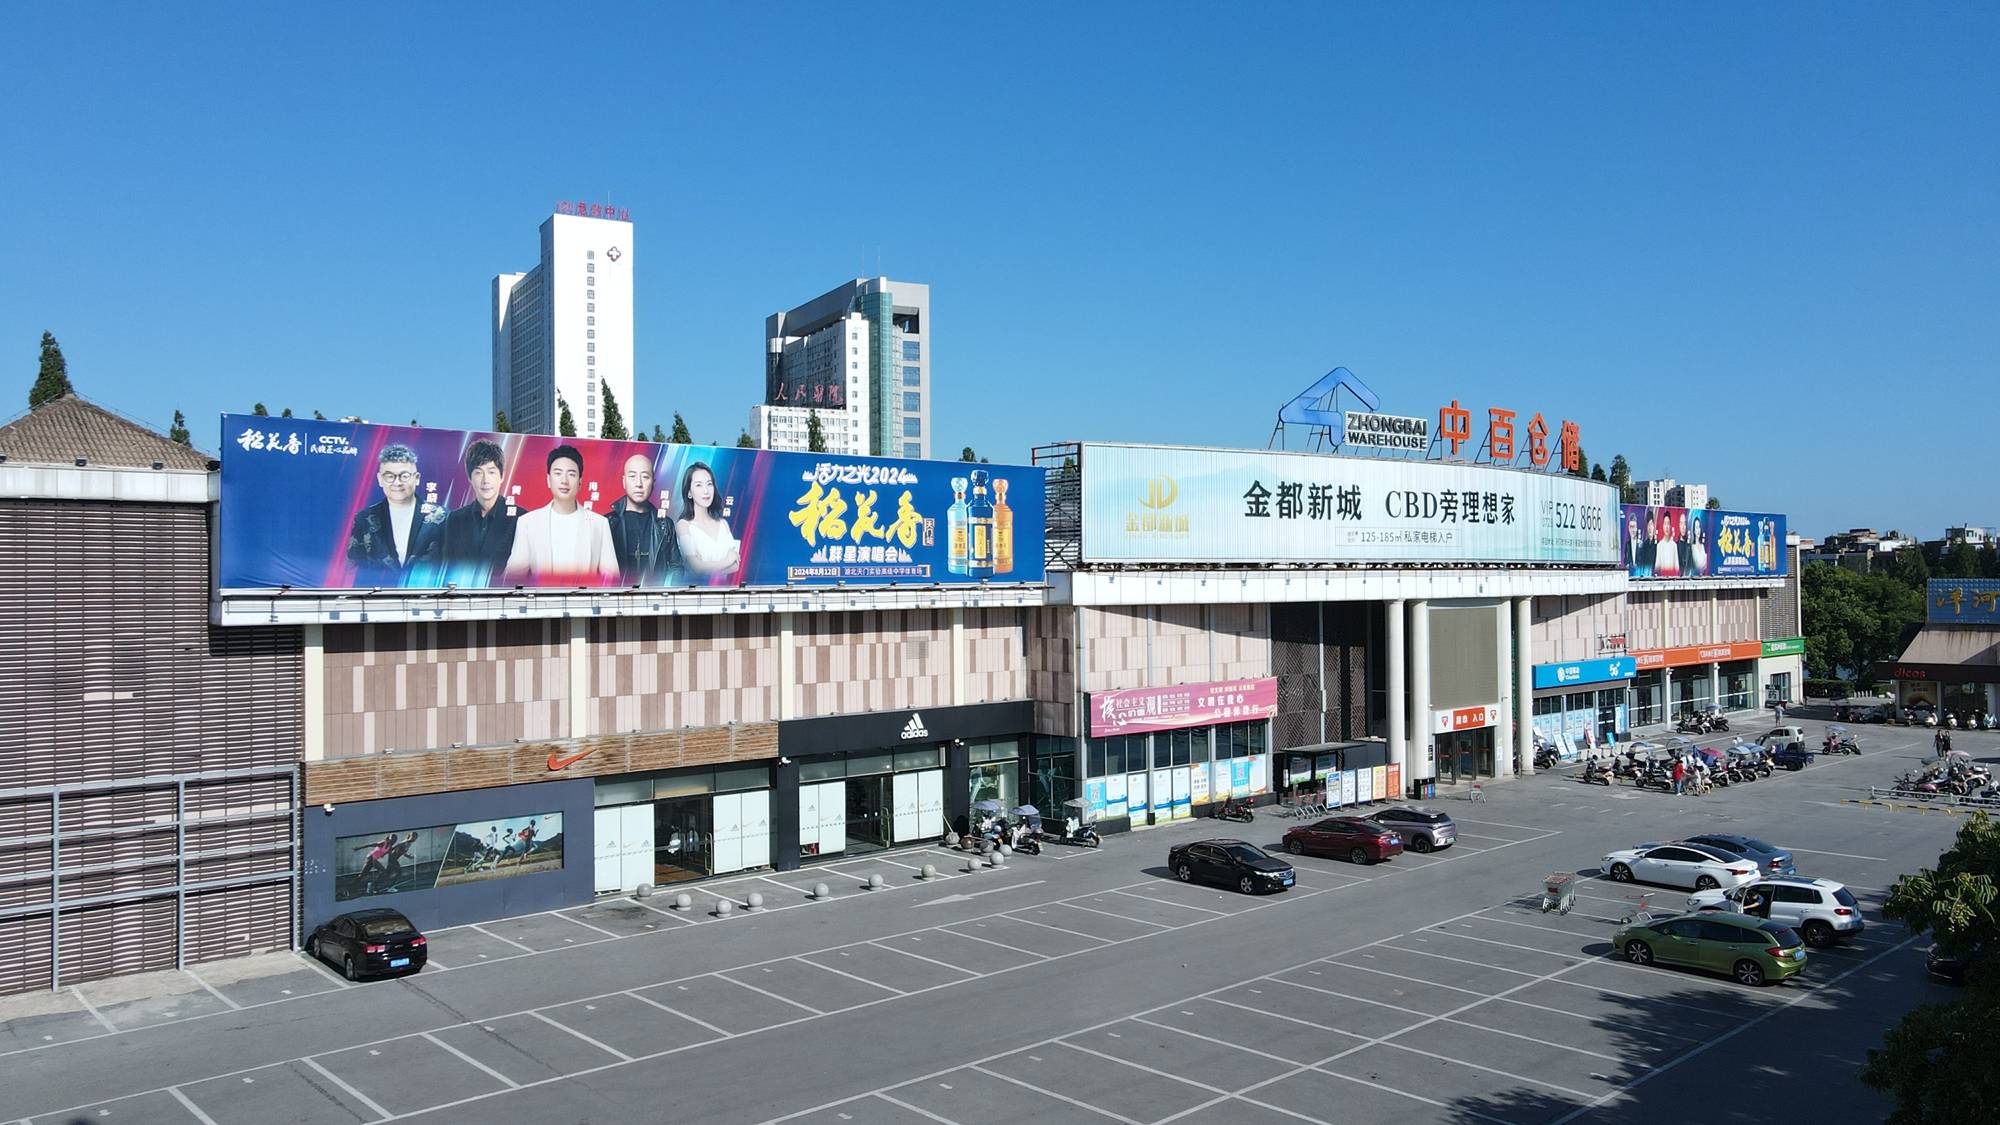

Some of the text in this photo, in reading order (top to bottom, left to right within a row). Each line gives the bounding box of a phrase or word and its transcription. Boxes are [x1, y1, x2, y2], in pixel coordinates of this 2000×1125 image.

[1347, 413, 1427, 436] ZHONGBAI
[1440, 399, 1580, 471] 中百仓储
[237, 428, 302, 455] 稻花香
[1348, 431, 1427, 449] WAREHOUSE
[814, 462, 907, 485] 活力之光2024
[1243, 480, 1362, 521] 金都新城
[1385, 489, 1515, 526] CBD旁理想家
[788, 481, 923, 549] 稻花香
[1555, 502, 1602, 532] 522 8666
[1404, 530, 1453, 544] 私家电梯入户
[829, 545, 898, 563] 群星演唱会
[1473, 712, 1484, 722] 入口
[901, 729, 928, 739] adidas
